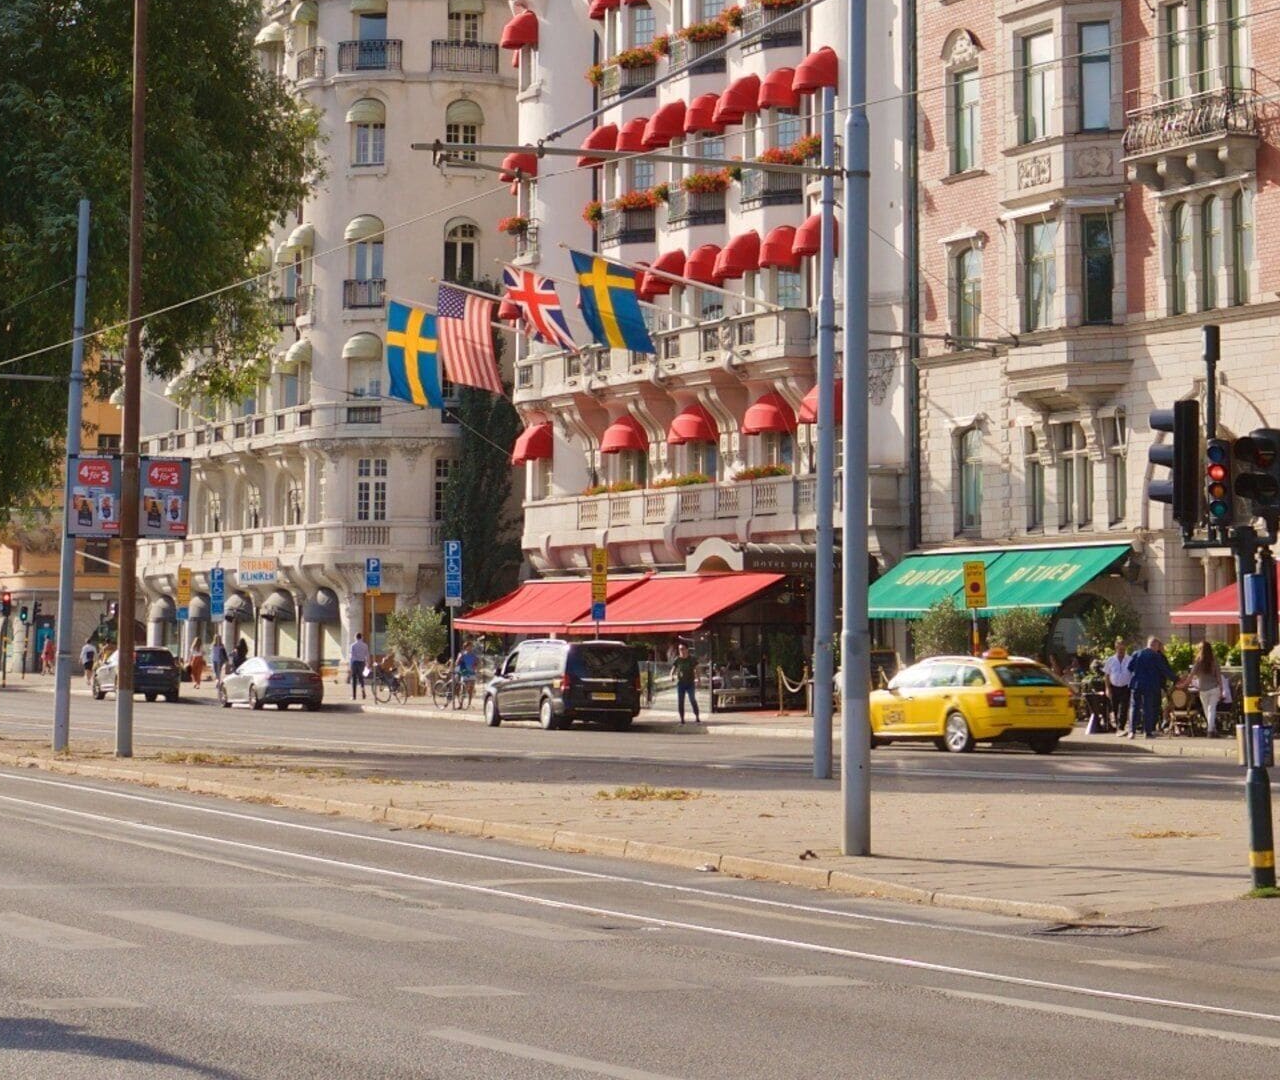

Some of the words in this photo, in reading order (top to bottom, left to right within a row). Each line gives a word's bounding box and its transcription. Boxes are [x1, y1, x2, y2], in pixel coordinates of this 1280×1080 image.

[80, 465, 89, 478] 4
[101, 470, 109, 483] 3
[150, 467, 159, 479] 4
[170, 472, 179, 485] 3
[449, 543, 458, 556] P
[241, 560, 274, 571] STRAND
[370, 559, 378, 571] P
[214, 569, 222, 581] P
[241, 571, 274, 581] KLINIKEN
